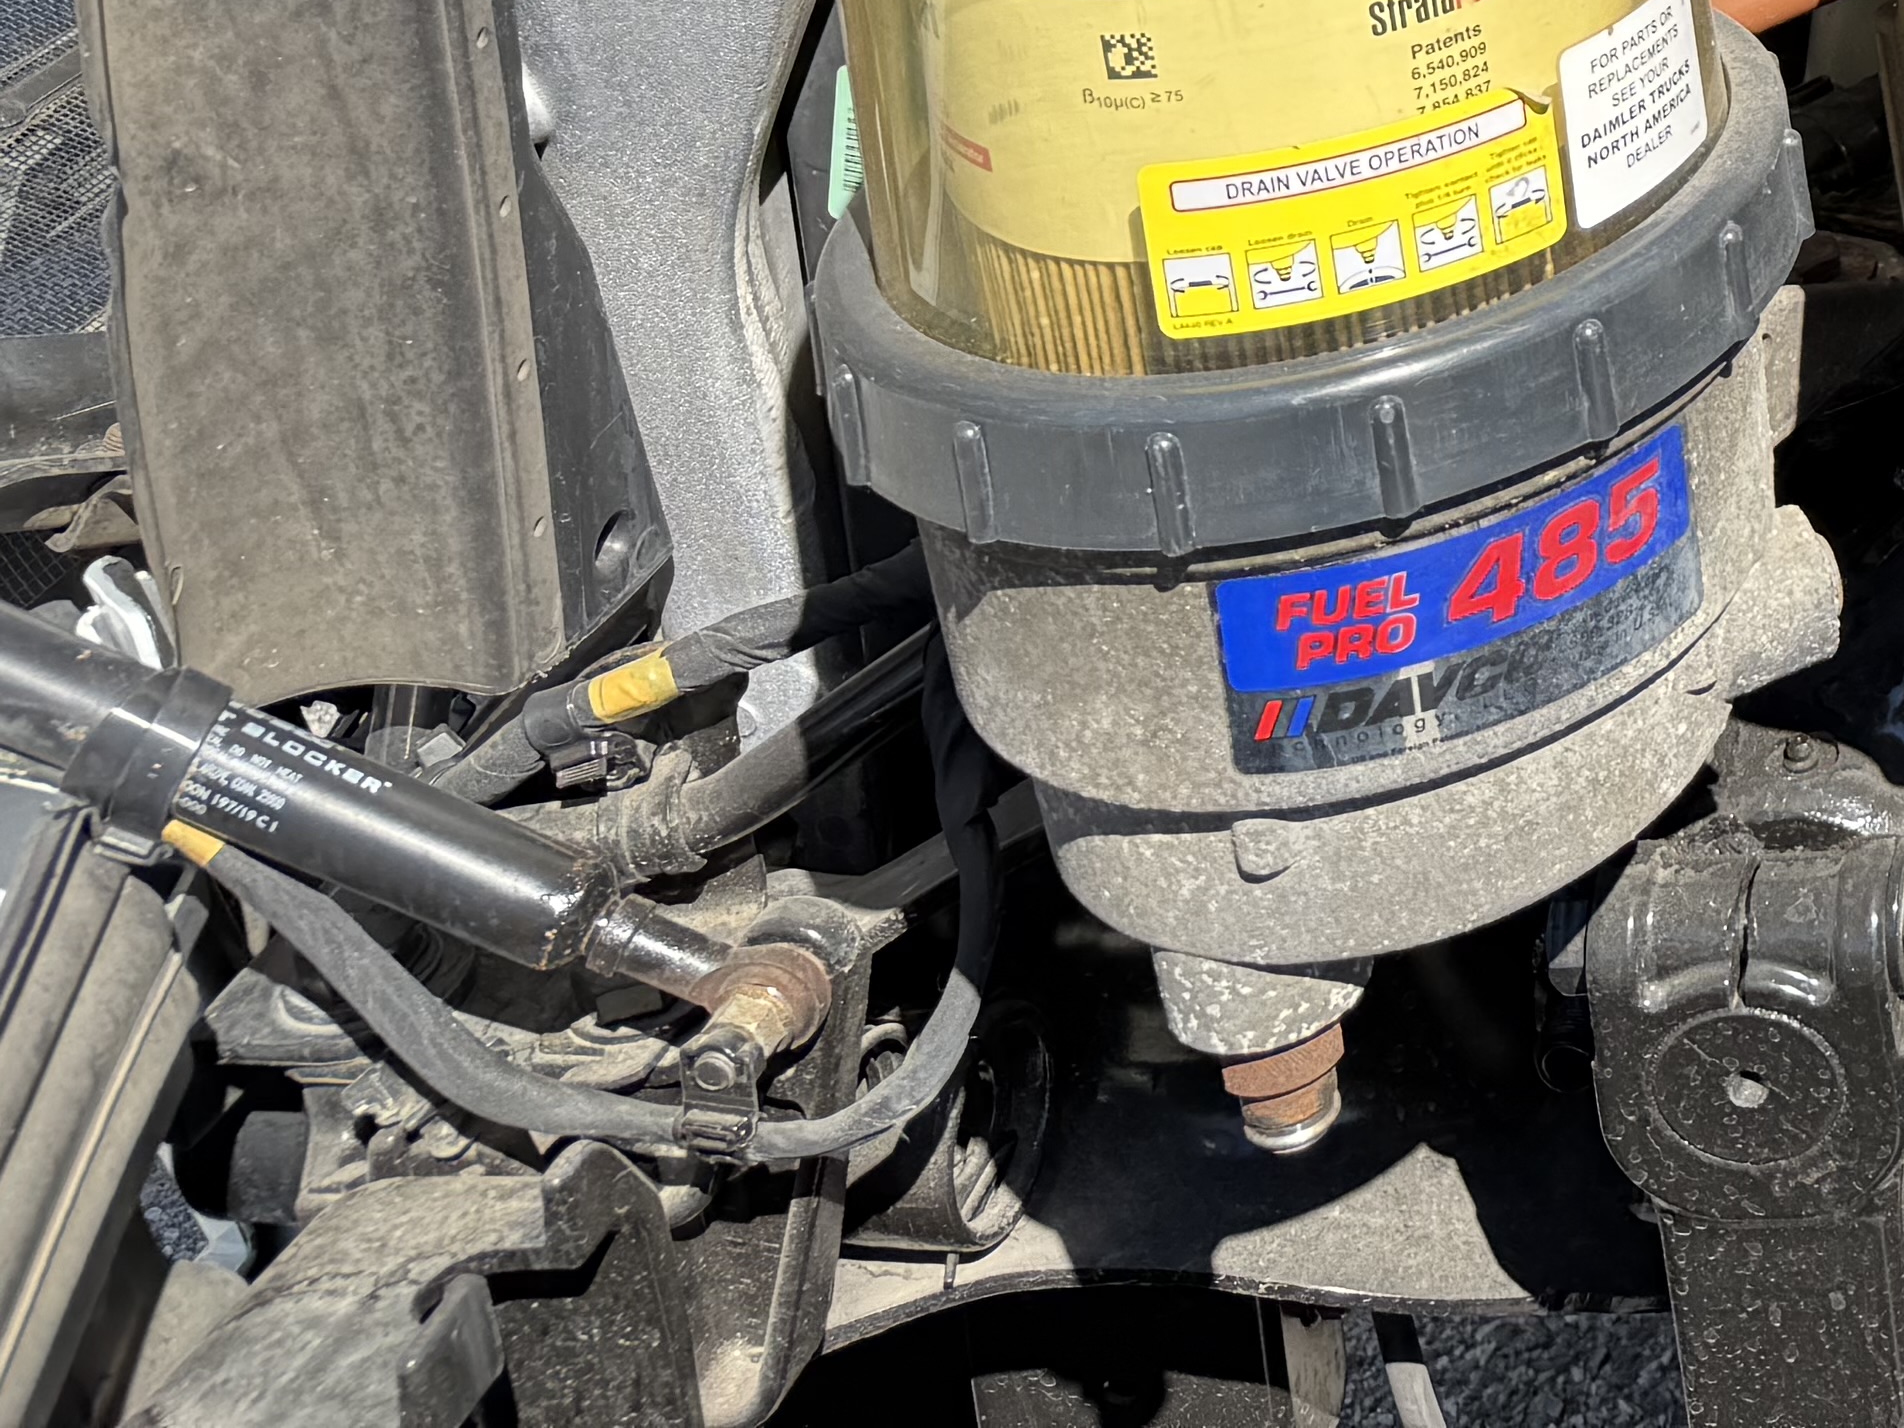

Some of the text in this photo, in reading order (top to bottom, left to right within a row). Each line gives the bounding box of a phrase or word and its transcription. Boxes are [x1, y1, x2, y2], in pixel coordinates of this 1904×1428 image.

[1411, 24, 1482, 59] Patents
[1411, 41, 1487, 80] 6,540,909
[1587, 24, 1679, 99] REPLACEMENTS
[1590, 5, 1673, 74] FOR PARTS OR
[1165, 90, 1183, 103] 75
[1413, 61, 1489, 100] 7,150,824
[1581, 99, 1647, 149] DAIMLER
[1649, 59, 1691, 104] TRUCKS
[1611, 56, 1670, 108] SEE YOUR
[1587, 126, 1640, 169] NORTH
[1644, 83, 1692, 134] AMERICA
[1626, 124, 1673, 169] DEALER
[1226, 177, 1290, 201] DRAIN
[1298, 159, 1361, 188] VALVE
[1368, 123, 1481, 172] OPERATION
[1276, 572, 1420, 632] FUEL
[1448, 457, 1660, 624] 485
[1296, 613, 1417, 671] PRO
